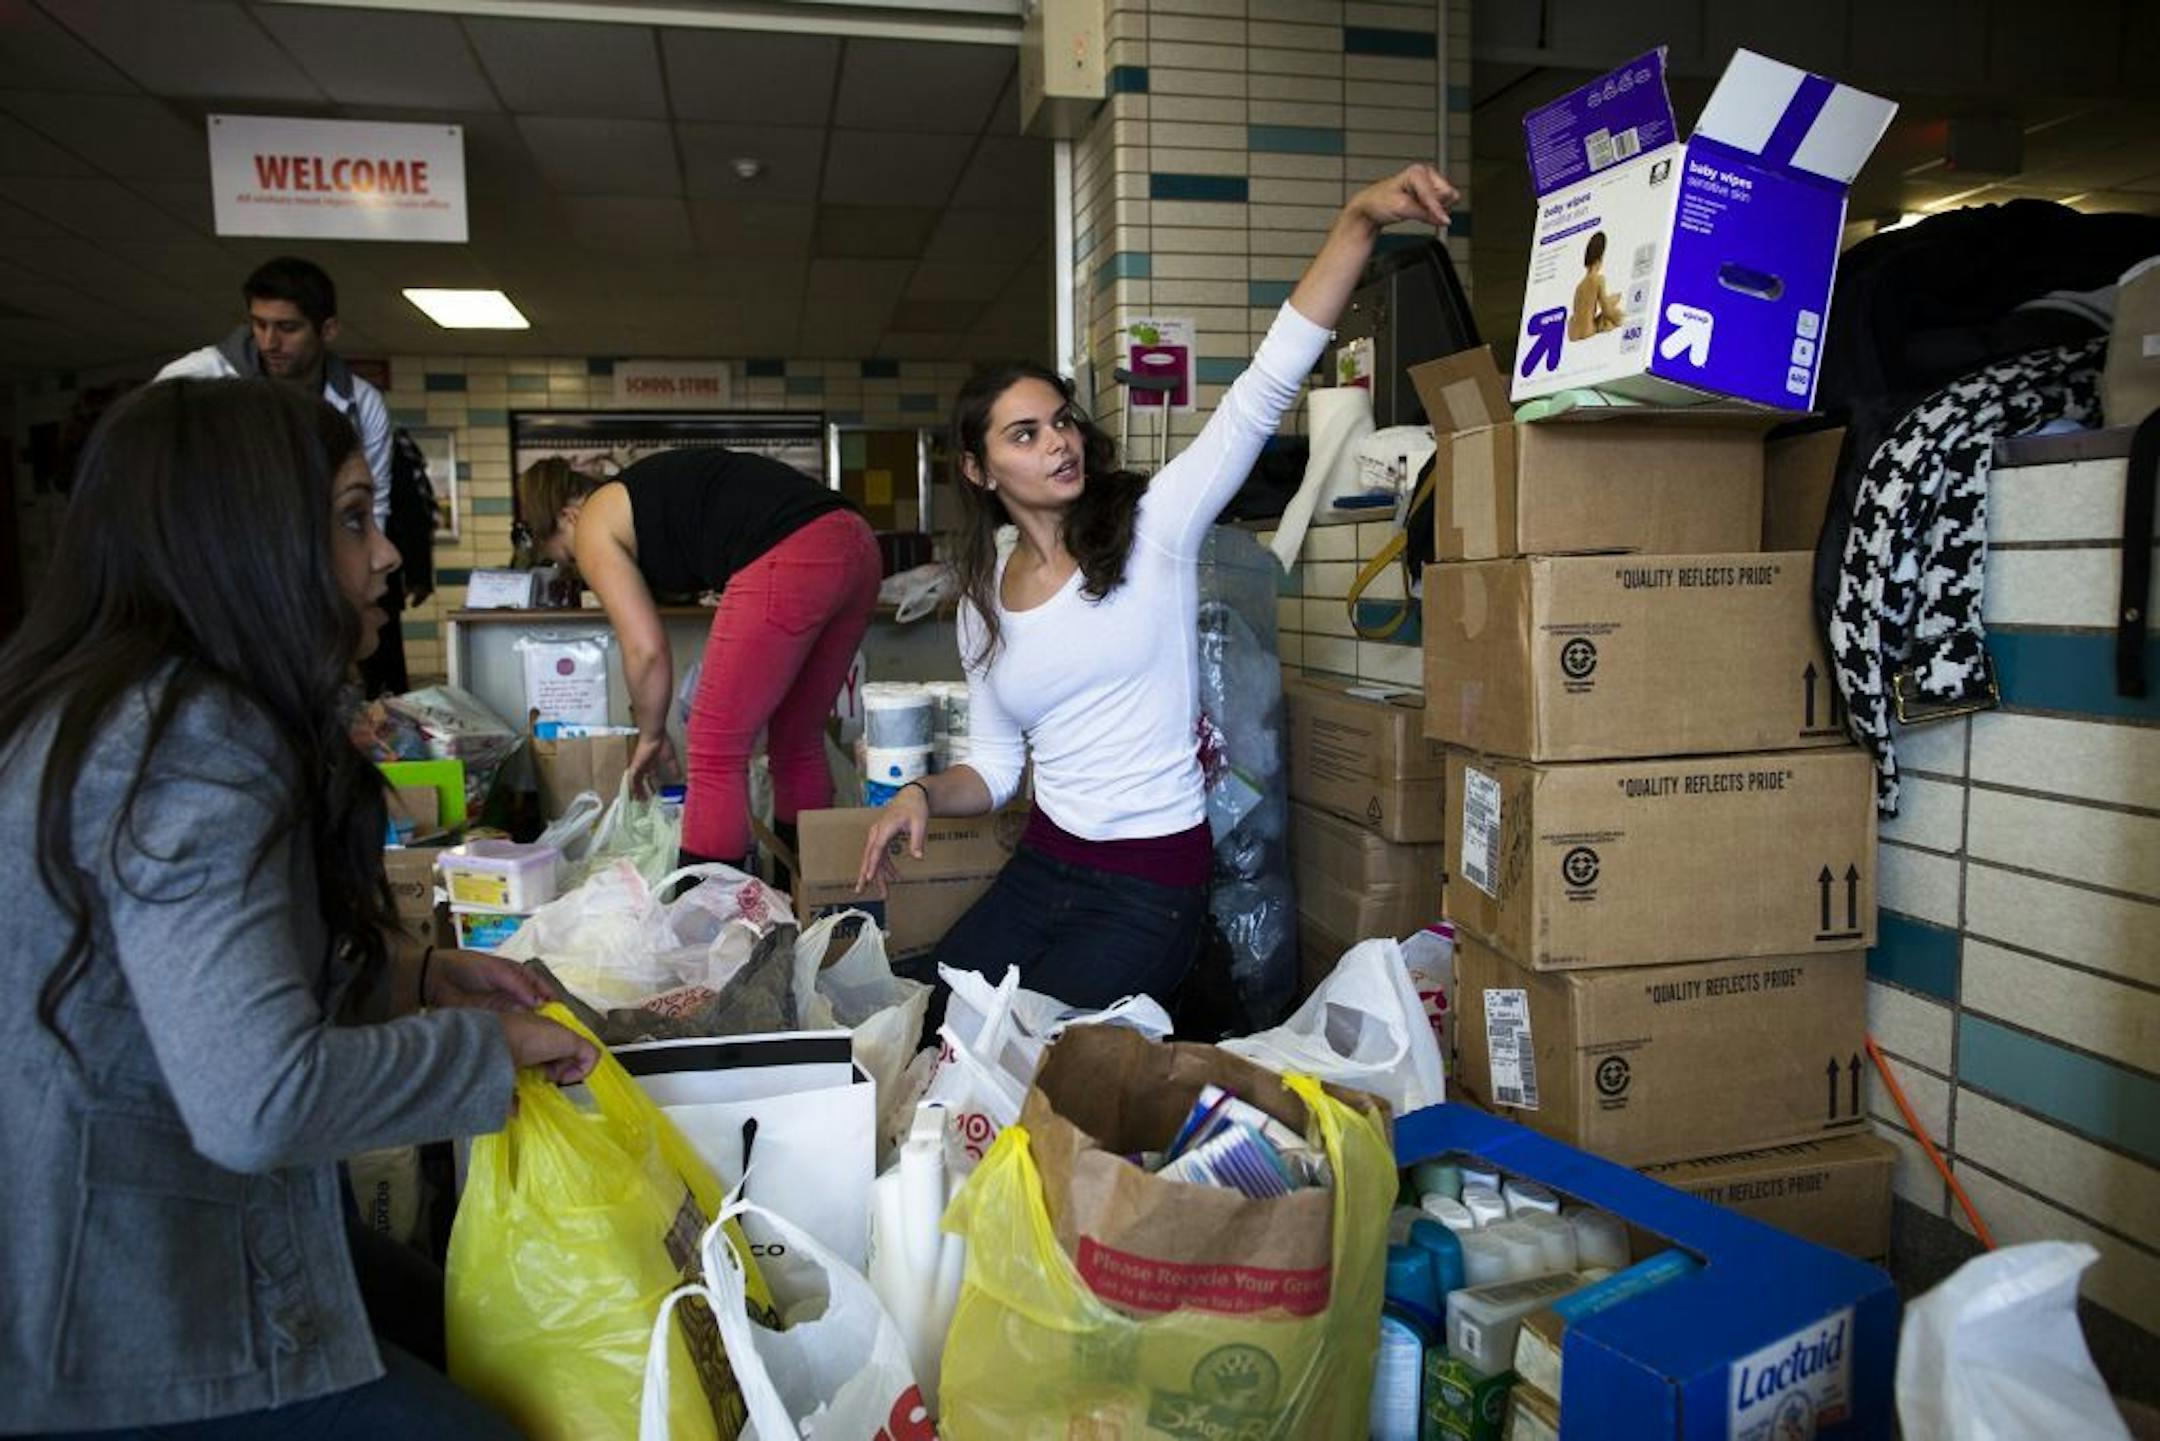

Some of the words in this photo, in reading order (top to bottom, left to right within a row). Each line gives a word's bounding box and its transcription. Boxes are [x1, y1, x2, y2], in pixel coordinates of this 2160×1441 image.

[254, 154, 428, 194] WELCOME
[1689, 160, 1718, 181] baby
[1720, 172, 1752, 190] wipes
[1543, 203, 1564, 218] baby
[1566, 192, 1591, 209] wipes
[1679, 568, 1735, 588] REFLECTS
[1684, 773, 1744, 795] REFLECTS
[1705, 973, 1760, 997] REFLECTS
[1728, 1179, 1785, 1201] REFLECTS
[1092, 1250, 1152, 1282] Please
[1157, 1267, 1232, 1291] Recycle
[1235, 1272, 1278, 1294] Your
[1737, 1319, 1846, 1412] Lactaid
